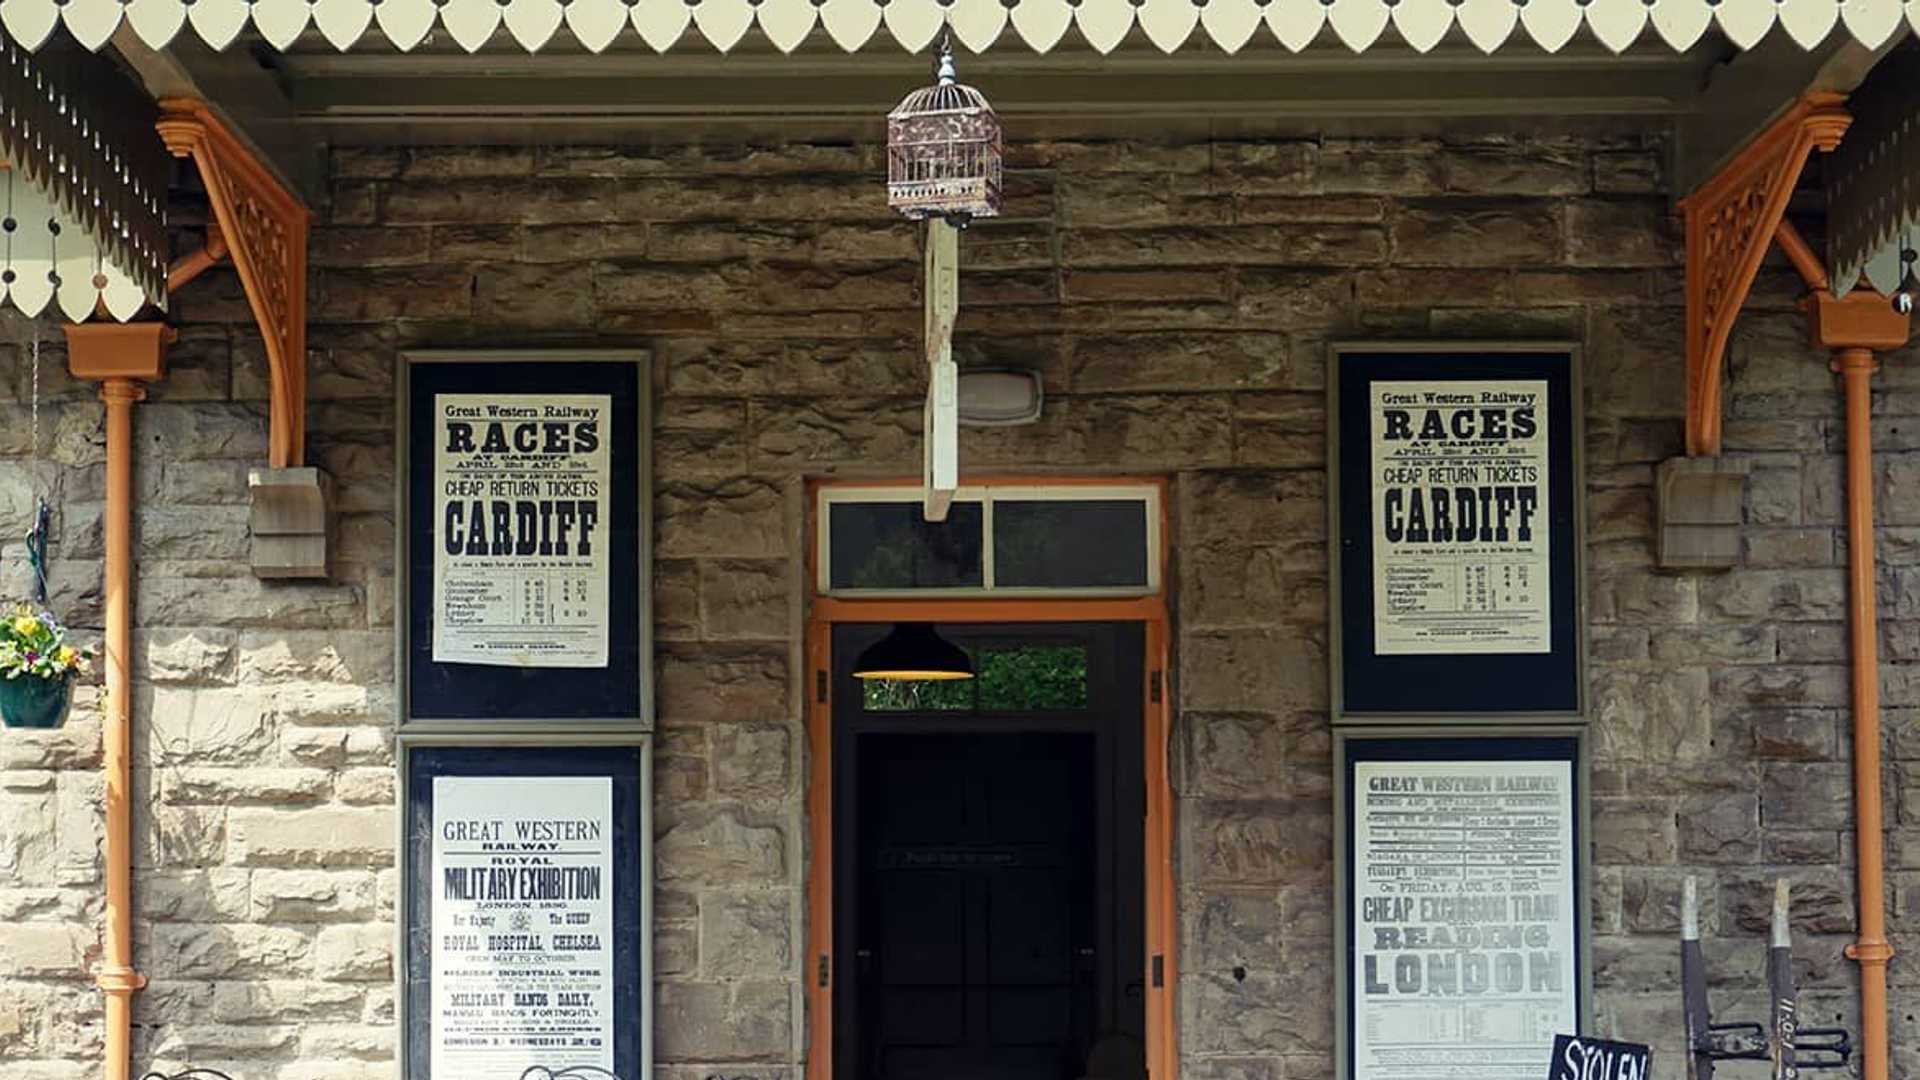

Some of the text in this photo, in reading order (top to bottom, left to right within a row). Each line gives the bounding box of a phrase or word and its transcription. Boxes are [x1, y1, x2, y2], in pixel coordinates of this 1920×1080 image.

[1382, 391, 1536, 406] Great Western Railway
[445, 405, 599, 420] Great Western Railway
[1383, 408, 1537, 440] RACES
[446, 422, 599, 453] RACES
[1384, 466, 1537, 484] CHEAP RETURN TICKETS
[445, 481, 598, 496] CHEAP RETURN TICKETS
[1385, 486, 1537, 543] CARDIFF
[445, 500, 598, 556] CARDIFF
[1369, 777, 1419, 792] GREAT
[1422, 776, 1491, 792] WESTERN
[443, 821, 600, 841] GREAT WESTERN
[444, 866, 600, 900] MILITARY EXHIBITION
[1363, 898, 1413, 922] CHEAP
[1374, 926, 1552, 950] READING
[1364, 953, 1562, 994] LONDON
[1562, 1039, 1647, 1080] STOLEN
